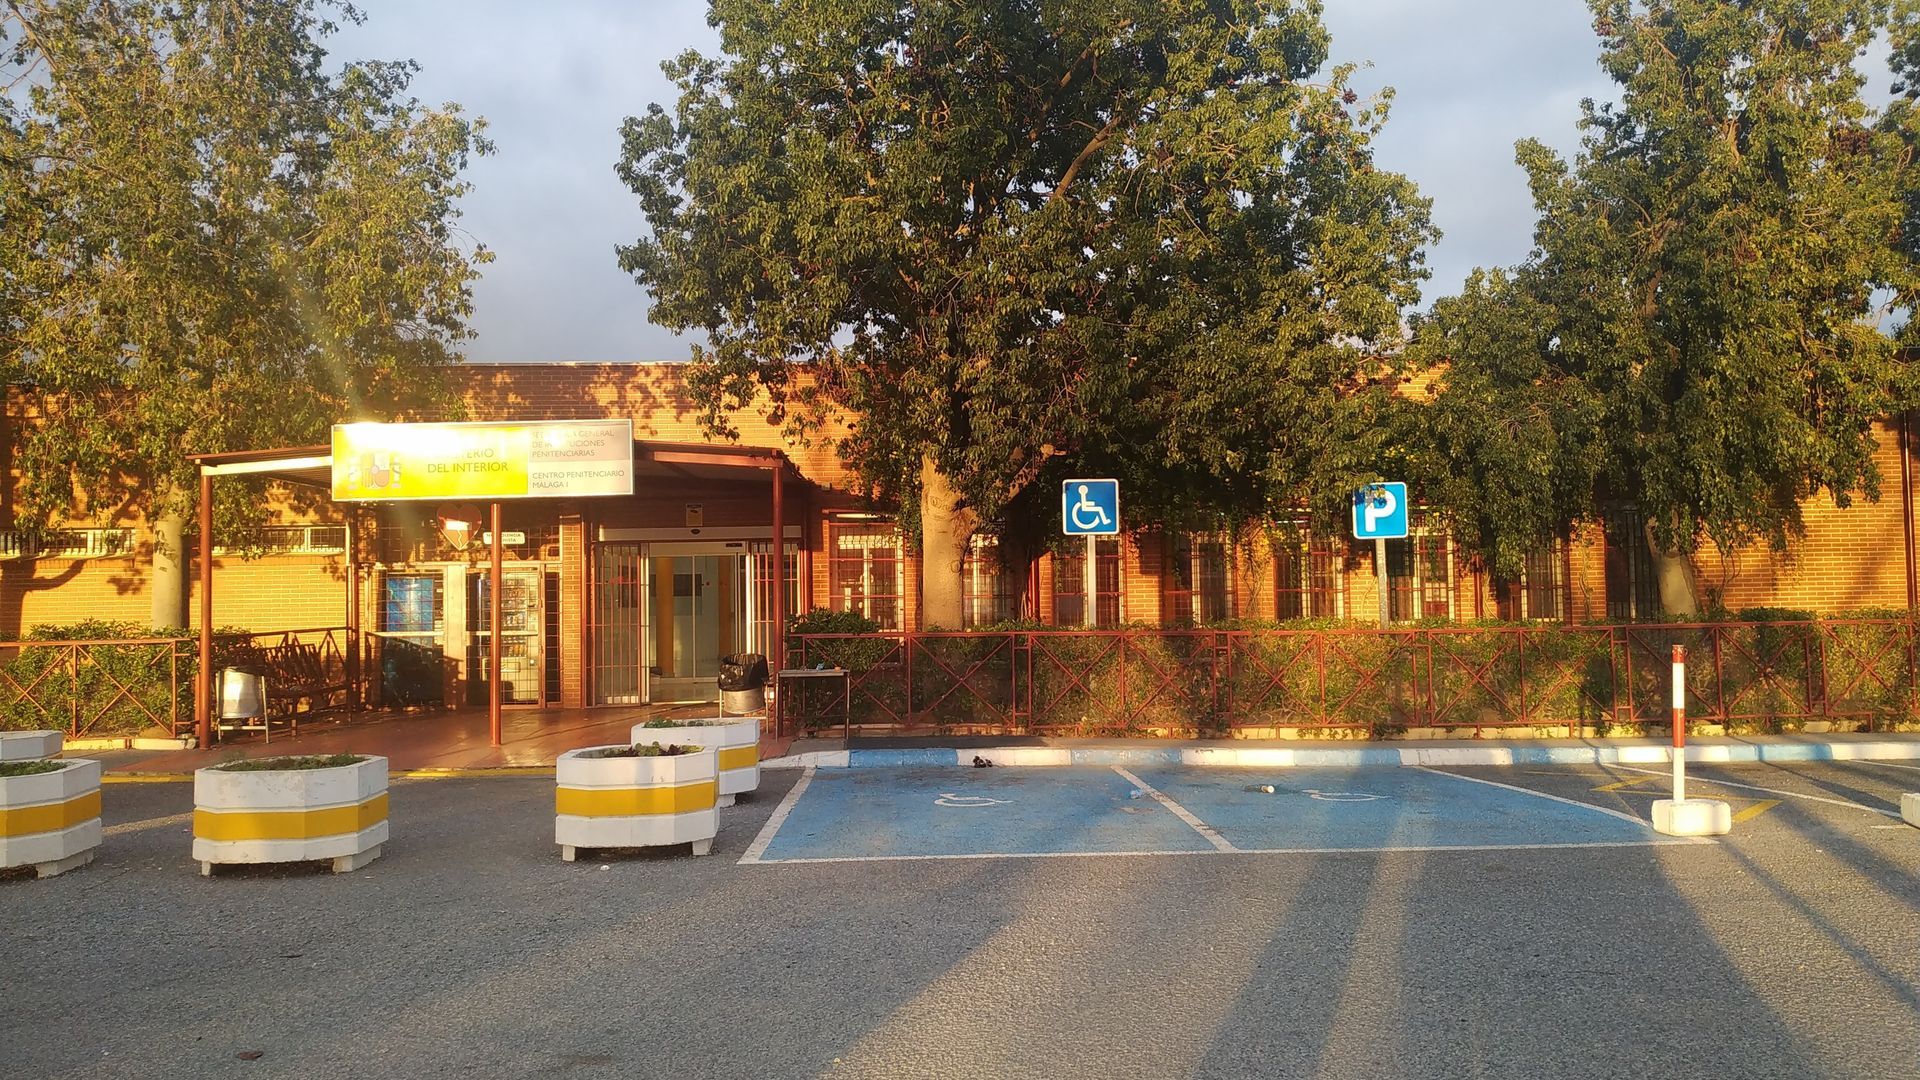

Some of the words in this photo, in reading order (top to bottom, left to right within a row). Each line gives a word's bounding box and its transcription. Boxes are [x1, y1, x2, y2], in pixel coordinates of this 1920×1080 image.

[578, 429, 615, 438] GENERAL
[532, 440, 544, 449] DE
[532, 449, 595, 458] PENITENCIARIAS
[427, 463, 450, 473] DEL
[453, 462, 509, 473] INTERIOR
[532, 471, 565, 480] CENTRO
[566, 469, 625, 479] PENITENCIARIO
[1365, 490, 1397, 533] P
